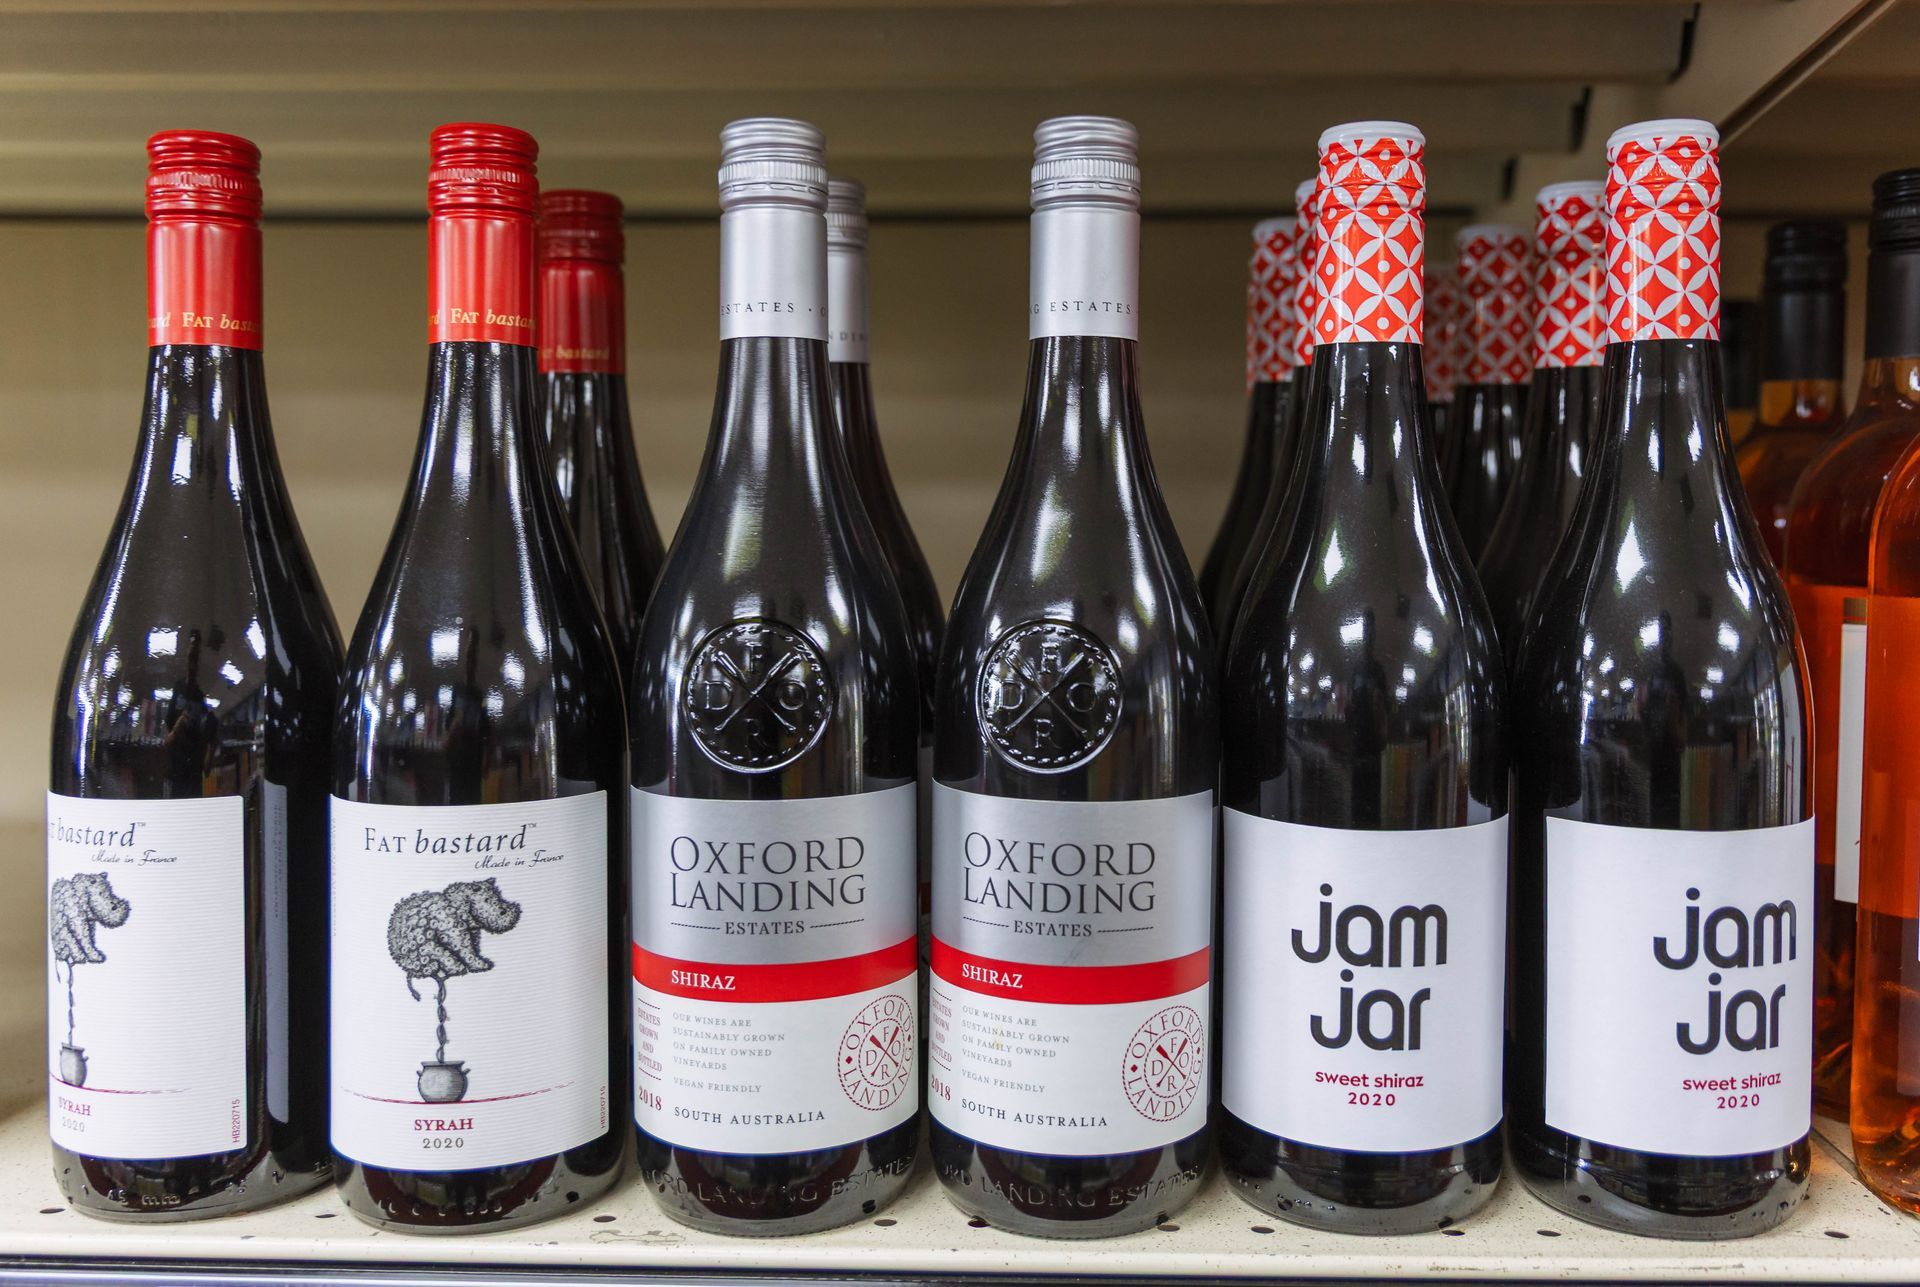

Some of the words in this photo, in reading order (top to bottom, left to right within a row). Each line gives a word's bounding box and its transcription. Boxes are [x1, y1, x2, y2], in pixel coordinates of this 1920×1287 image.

[450, 308, 480, 324] FAT
[721, 302, 794, 315] ESTATES
[1050, 301, 1131, 314] ESTATES
[182, 311, 214, 328] FAT
[57, 817, 135, 847] bastard
[364, 827, 406, 853] FAT
[415, 823, 528, 854] bastard
[91, 850, 120, 863] Made
[137, 849, 178, 866] France
[474, 854, 511, 869] Made
[514, 857, 525, 866] in
[528, 849, 565, 868] France
[670, 835, 866, 875] OXFORD
[964, 832, 1156, 877] OXFORD
[670, 871, 866, 913] LANDING
[963, 866, 1156, 914] LANDING
[725, 919, 806, 936] ESTATES
[1014, 920, 1093, 938] ESTATES
[1291, 883, 1448, 968] jam
[1653, 887, 1797, 970] jam
[671, 969, 736, 991] SHIRAZ
[962, 963, 1024, 990] SHIRAZ
[673, 1012, 691, 1023] OUR
[694, 1015, 727, 1026] WINES
[730, 1019, 752, 1027] ARE
[962, 1005, 980, 1017] OUR
[983, 1010, 1013, 1024] WINES
[1017, 1017, 1037, 1027] ARE
[1310, 968, 1431, 1051] jar
[1676, 972, 1786, 1056] jar
[673, 1027, 739, 1042] SUSTAINABLY
[743, 1033, 785, 1042] GROWN
[846, 1000, 912, 1050] OXFORD
[962, 1019, 1025, 1040] SUSTAINABLY
[1028, 1033, 1070, 1044] GROWN
[1131, 1010, 1200, 1058] OXFORD
[673, 1041, 685, 1050] ON
[689, 1044, 726, 1056] FAMILY
[730, 1048, 772, 1057] OWNED
[962, 1034, 975, 1044] ON
[977, 1036, 1011, 1054] FAMILY
[1016, 1046, 1056, 1058] OWNED
[673, 1056, 727, 1071] VINEYARDS
[962, 1049, 1013, 1068] VINEYARDS
[673, 1077, 704, 1089] VEGAN
[707, 1082, 762, 1093] FRIENDLY
[844, 1047, 912, 1106] LANDING
[962, 1069, 990, 1084] VEGAN
[993, 1079, 1045, 1093] FRIENDLY
[1315, 1070, 1370, 1088] sweet
[1374, 1073, 1424, 1089] shiraz
[1683, 1075, 1737, 1091] sweet
[1741, 1072, 1782, 1089] shiraz
[638, 1086, 662, 1111] 2018
[931, 1075, 951, 1101] 2018
[1128, 1060, 1201, 1117] LANDING
[58, 1096, 92, 1117] SYRAH
[1348, 1092, 1396, 1107] 2020
[1717, 1094, 1761, 1109] 2020
[231, 1099, 241, 1143] HB220715
[674, 1106, 722, 1124] SOUTH
[730, 1110, 826, 1126] AUSTRALIA
[961, 1098, 1006, 1120] SOUTH
[1014, 1112, 1108, 1127] AUSTRALIA
[61, 1116, 86, 1134] 2020
[414, 1118, 475, 1131] SYRAH
[423, 1137, 464, 1149] 2020
